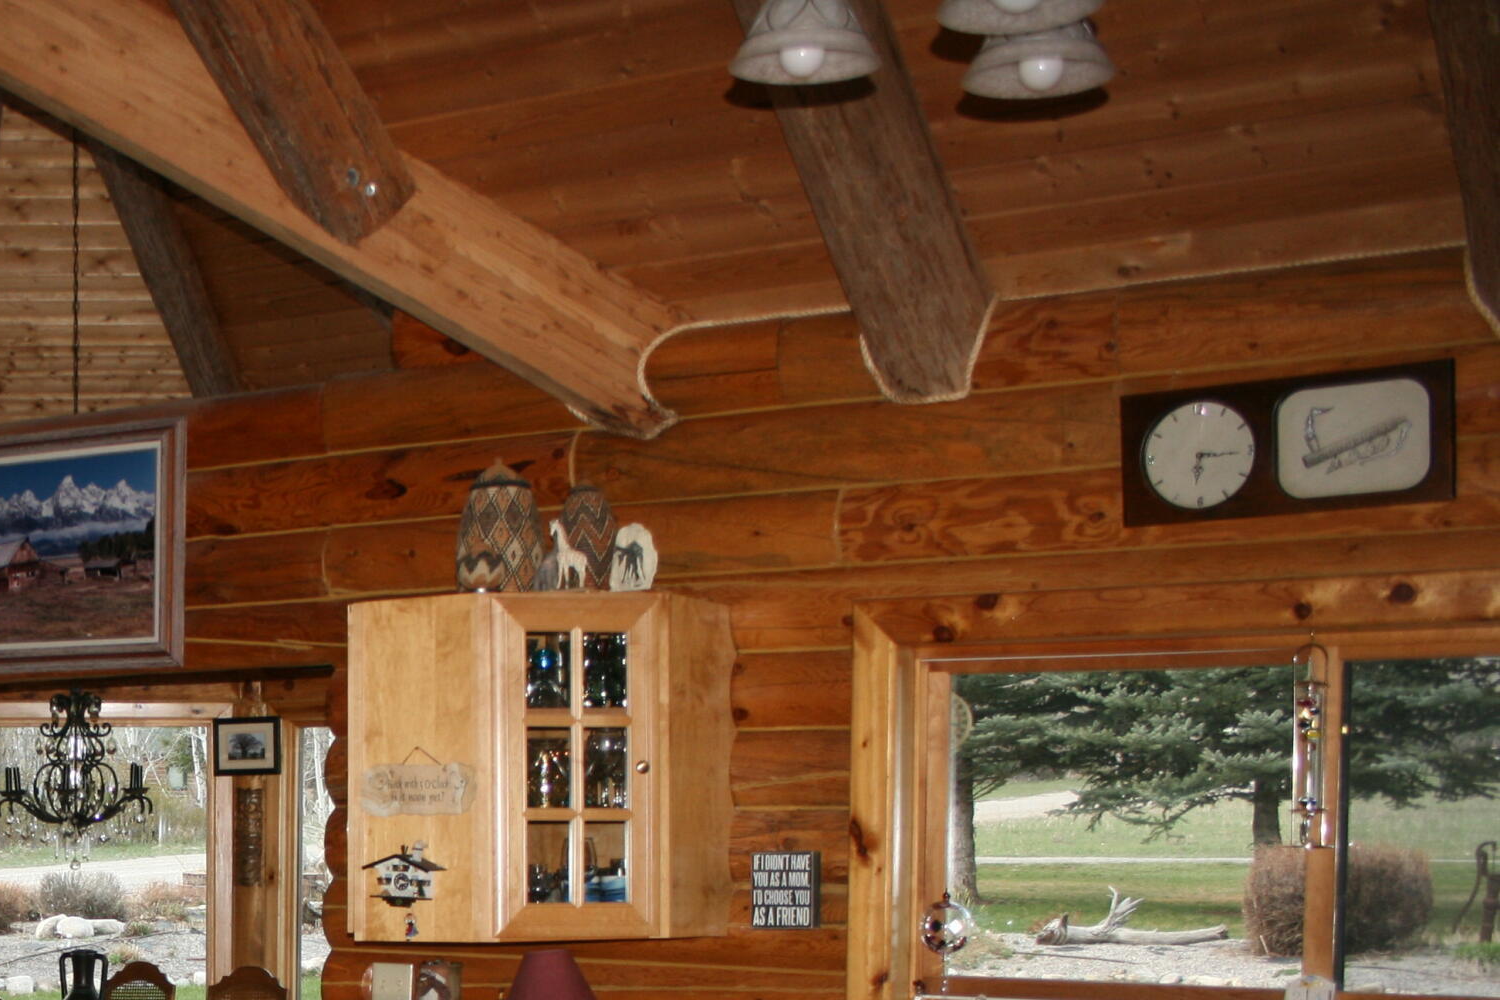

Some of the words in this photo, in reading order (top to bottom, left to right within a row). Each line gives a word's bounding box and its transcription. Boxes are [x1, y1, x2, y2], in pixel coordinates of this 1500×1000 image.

[753, 854, 760, 870] IF
[765, 854, 789, 870] DIDN'T
[790, 854, 810, 870] HAVE
[753, 872, 769, 887] YOU
[770, 872, 780, 887] AS
[781, 872, 787, 887] A
[753, 890, 763, 905] I'D
[764, 890, 794, 905] CHOOSE
[794, 890, 810, 905] YOU
[753, 907, 766, 926] AS
[767, 907, 774, 926] A
[776, 907, 810, 926] FRIEND
